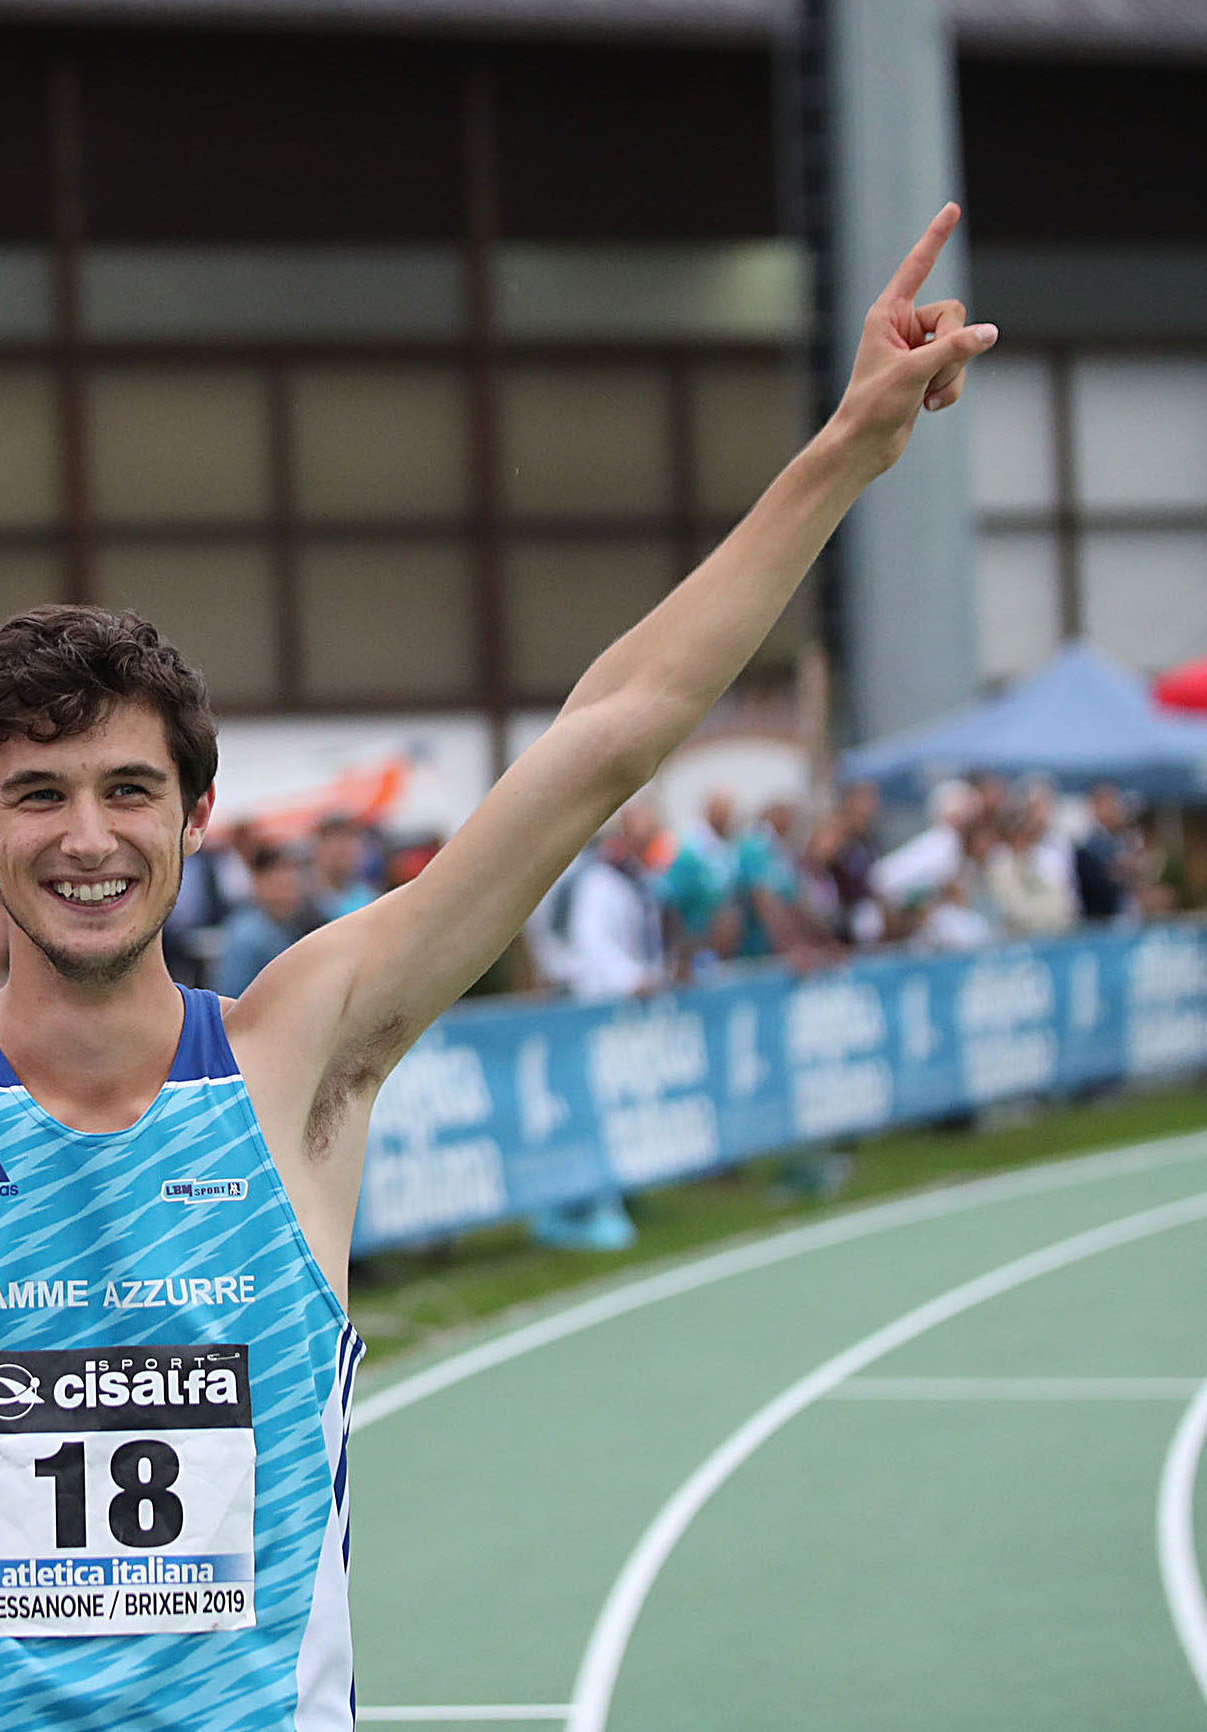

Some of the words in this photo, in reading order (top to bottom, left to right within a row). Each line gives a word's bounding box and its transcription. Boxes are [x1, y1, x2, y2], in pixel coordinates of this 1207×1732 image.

[194, 1186, 225, 1196] SPORT
[103, 1275, 255, 1308] AZZURRE
[98, 1357, 206, 1370] SPORT
[53, 1361, 239, 1408] cisalfa
[34, 1439, 184, 1549] 18
[1, 1559, 105, 1587] atletica
[112, 1556, 214, 1584] italiana
[124, 1592, 198, 1616] BRIXEN
[203, 1589, 245, 1614] 2019
